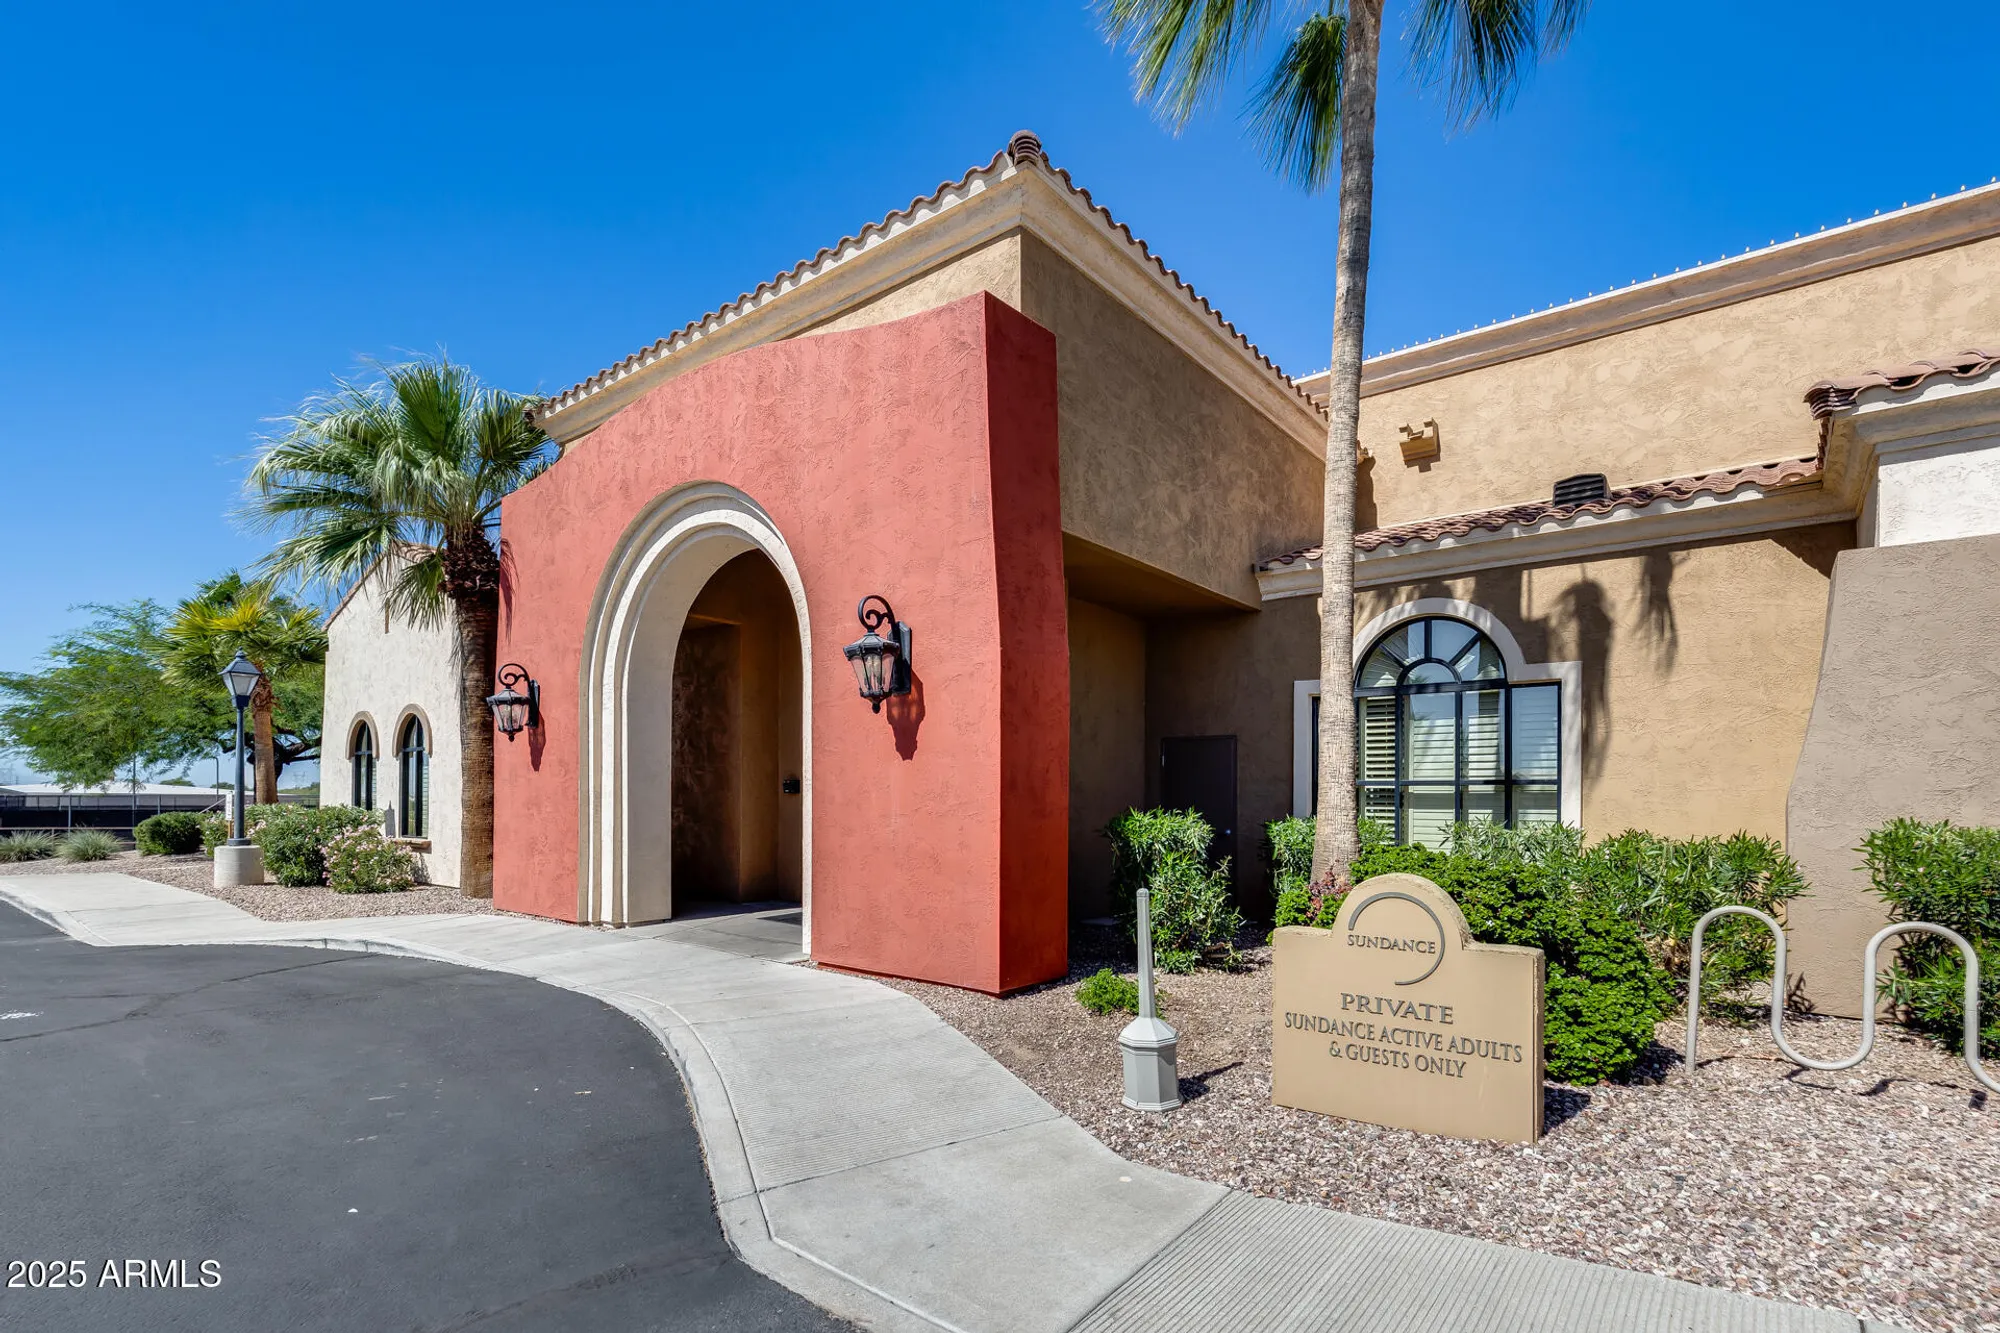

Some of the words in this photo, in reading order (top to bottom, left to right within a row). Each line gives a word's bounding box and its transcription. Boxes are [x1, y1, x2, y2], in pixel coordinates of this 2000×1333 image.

[1347, 934, 1436, 954] SUNDANCE
[1340, 992, 1454, 1025] PRIVATE
[1284, 1011, 1375, 1041] SUNDANCE
[1378, 1026, 1443, 1051] ACTIVE
[1446, 1035, 1523, 1063] ADULTS
[1328, 1040, 1343, 1058] &
[1345, 1043, 1410, 1069] GUESTS
[1414, 1054, 1467, 1078] ONLY
